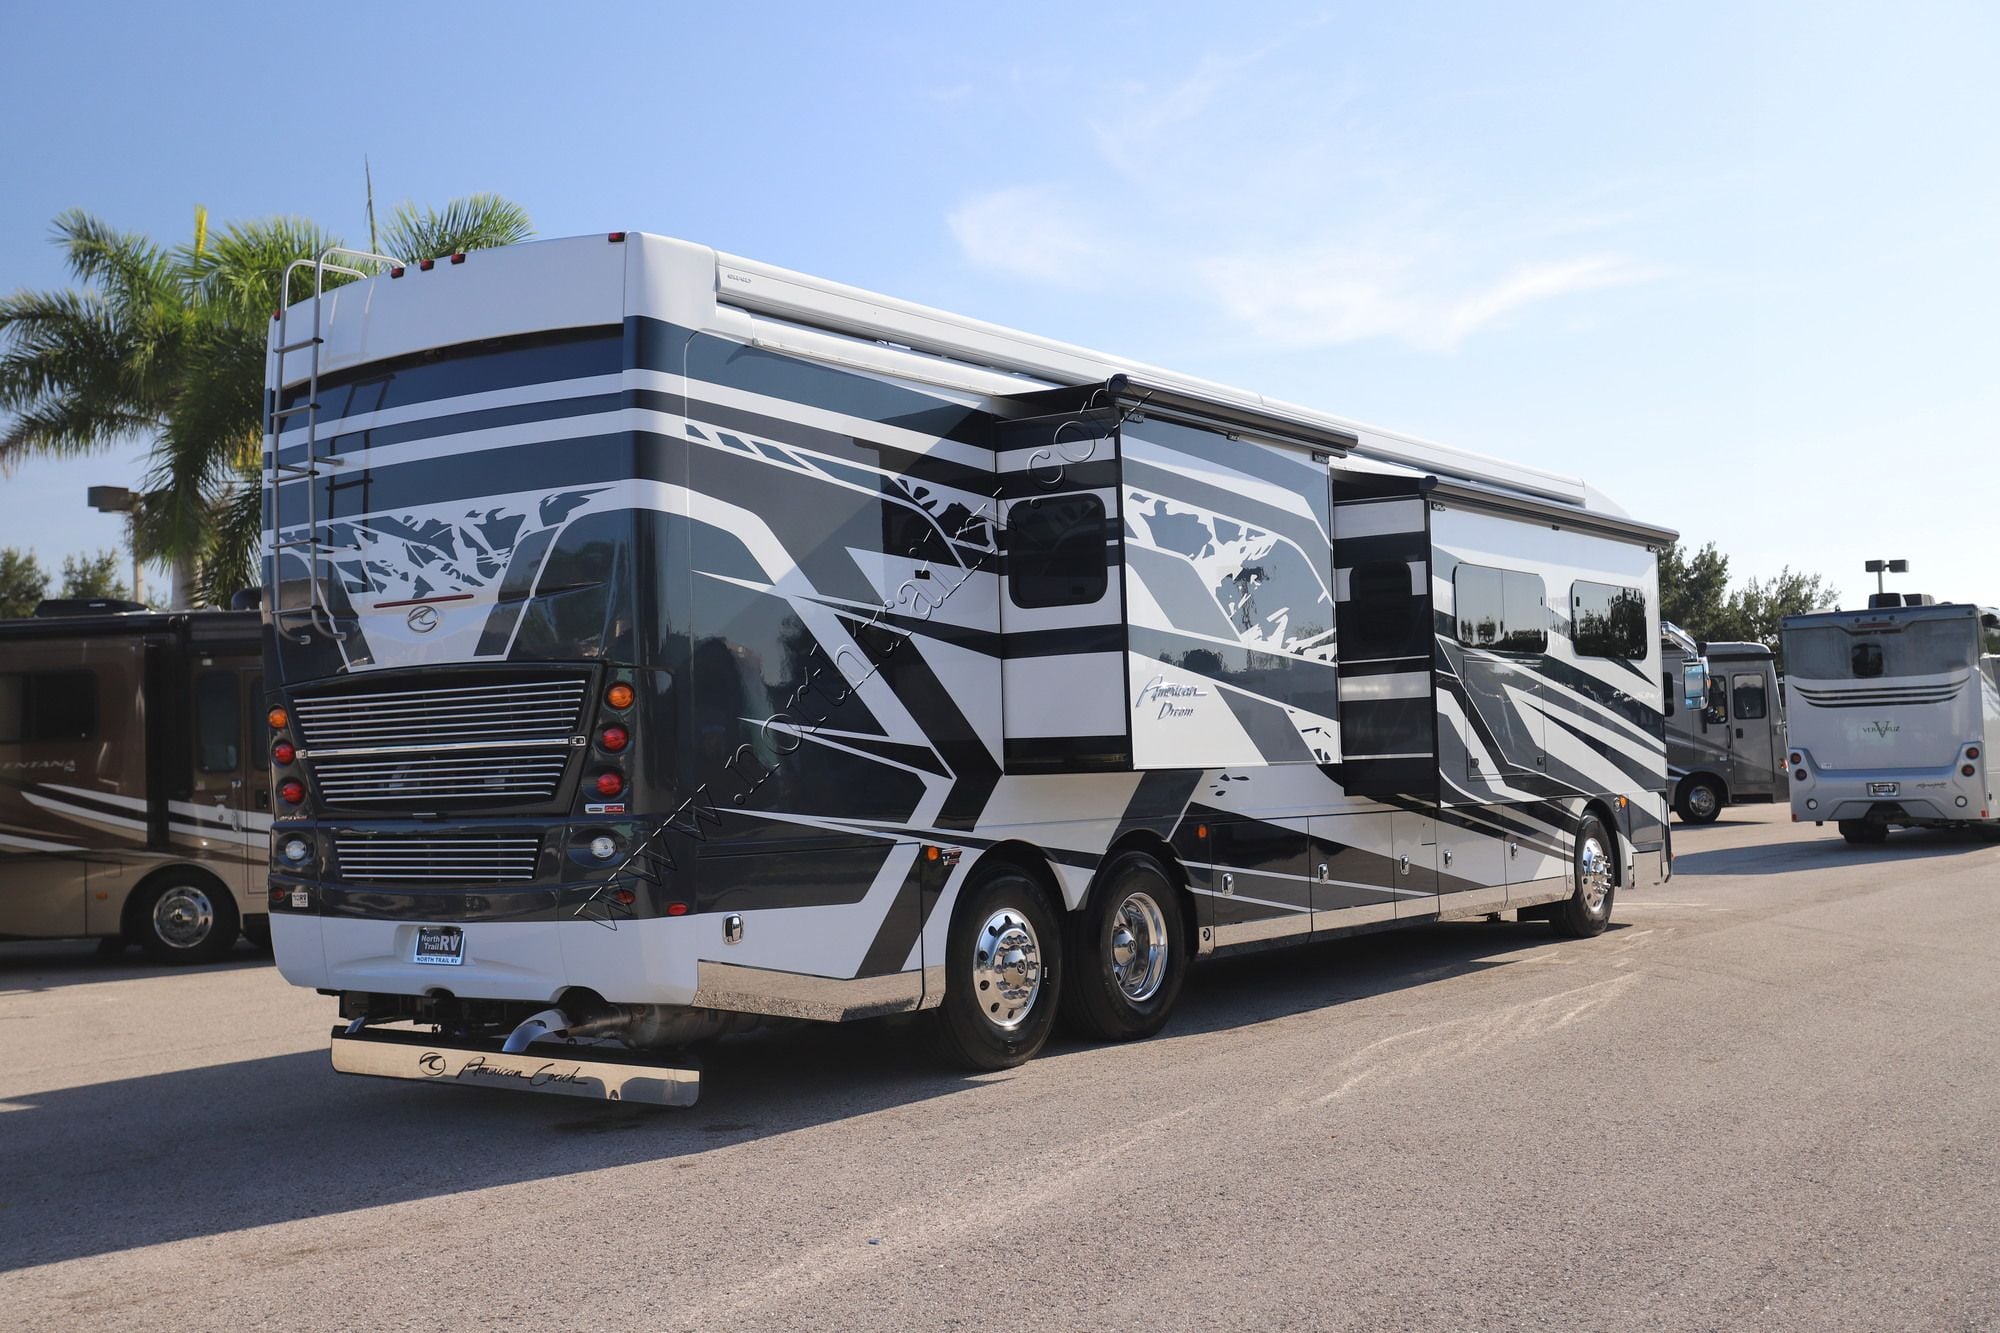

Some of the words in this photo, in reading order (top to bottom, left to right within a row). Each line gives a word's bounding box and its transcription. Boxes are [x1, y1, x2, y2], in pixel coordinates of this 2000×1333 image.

[1135, 675, 1208, 708] American
[1157, 701, 1194, 720] Dream
[421, 935, 440, 943] North
[440, 935, 460, 951] RV
[424, 943, 439, 951] Trail
[456, 1056, 531, 1079] American
[529, 1063, 588, 1086] Coach
